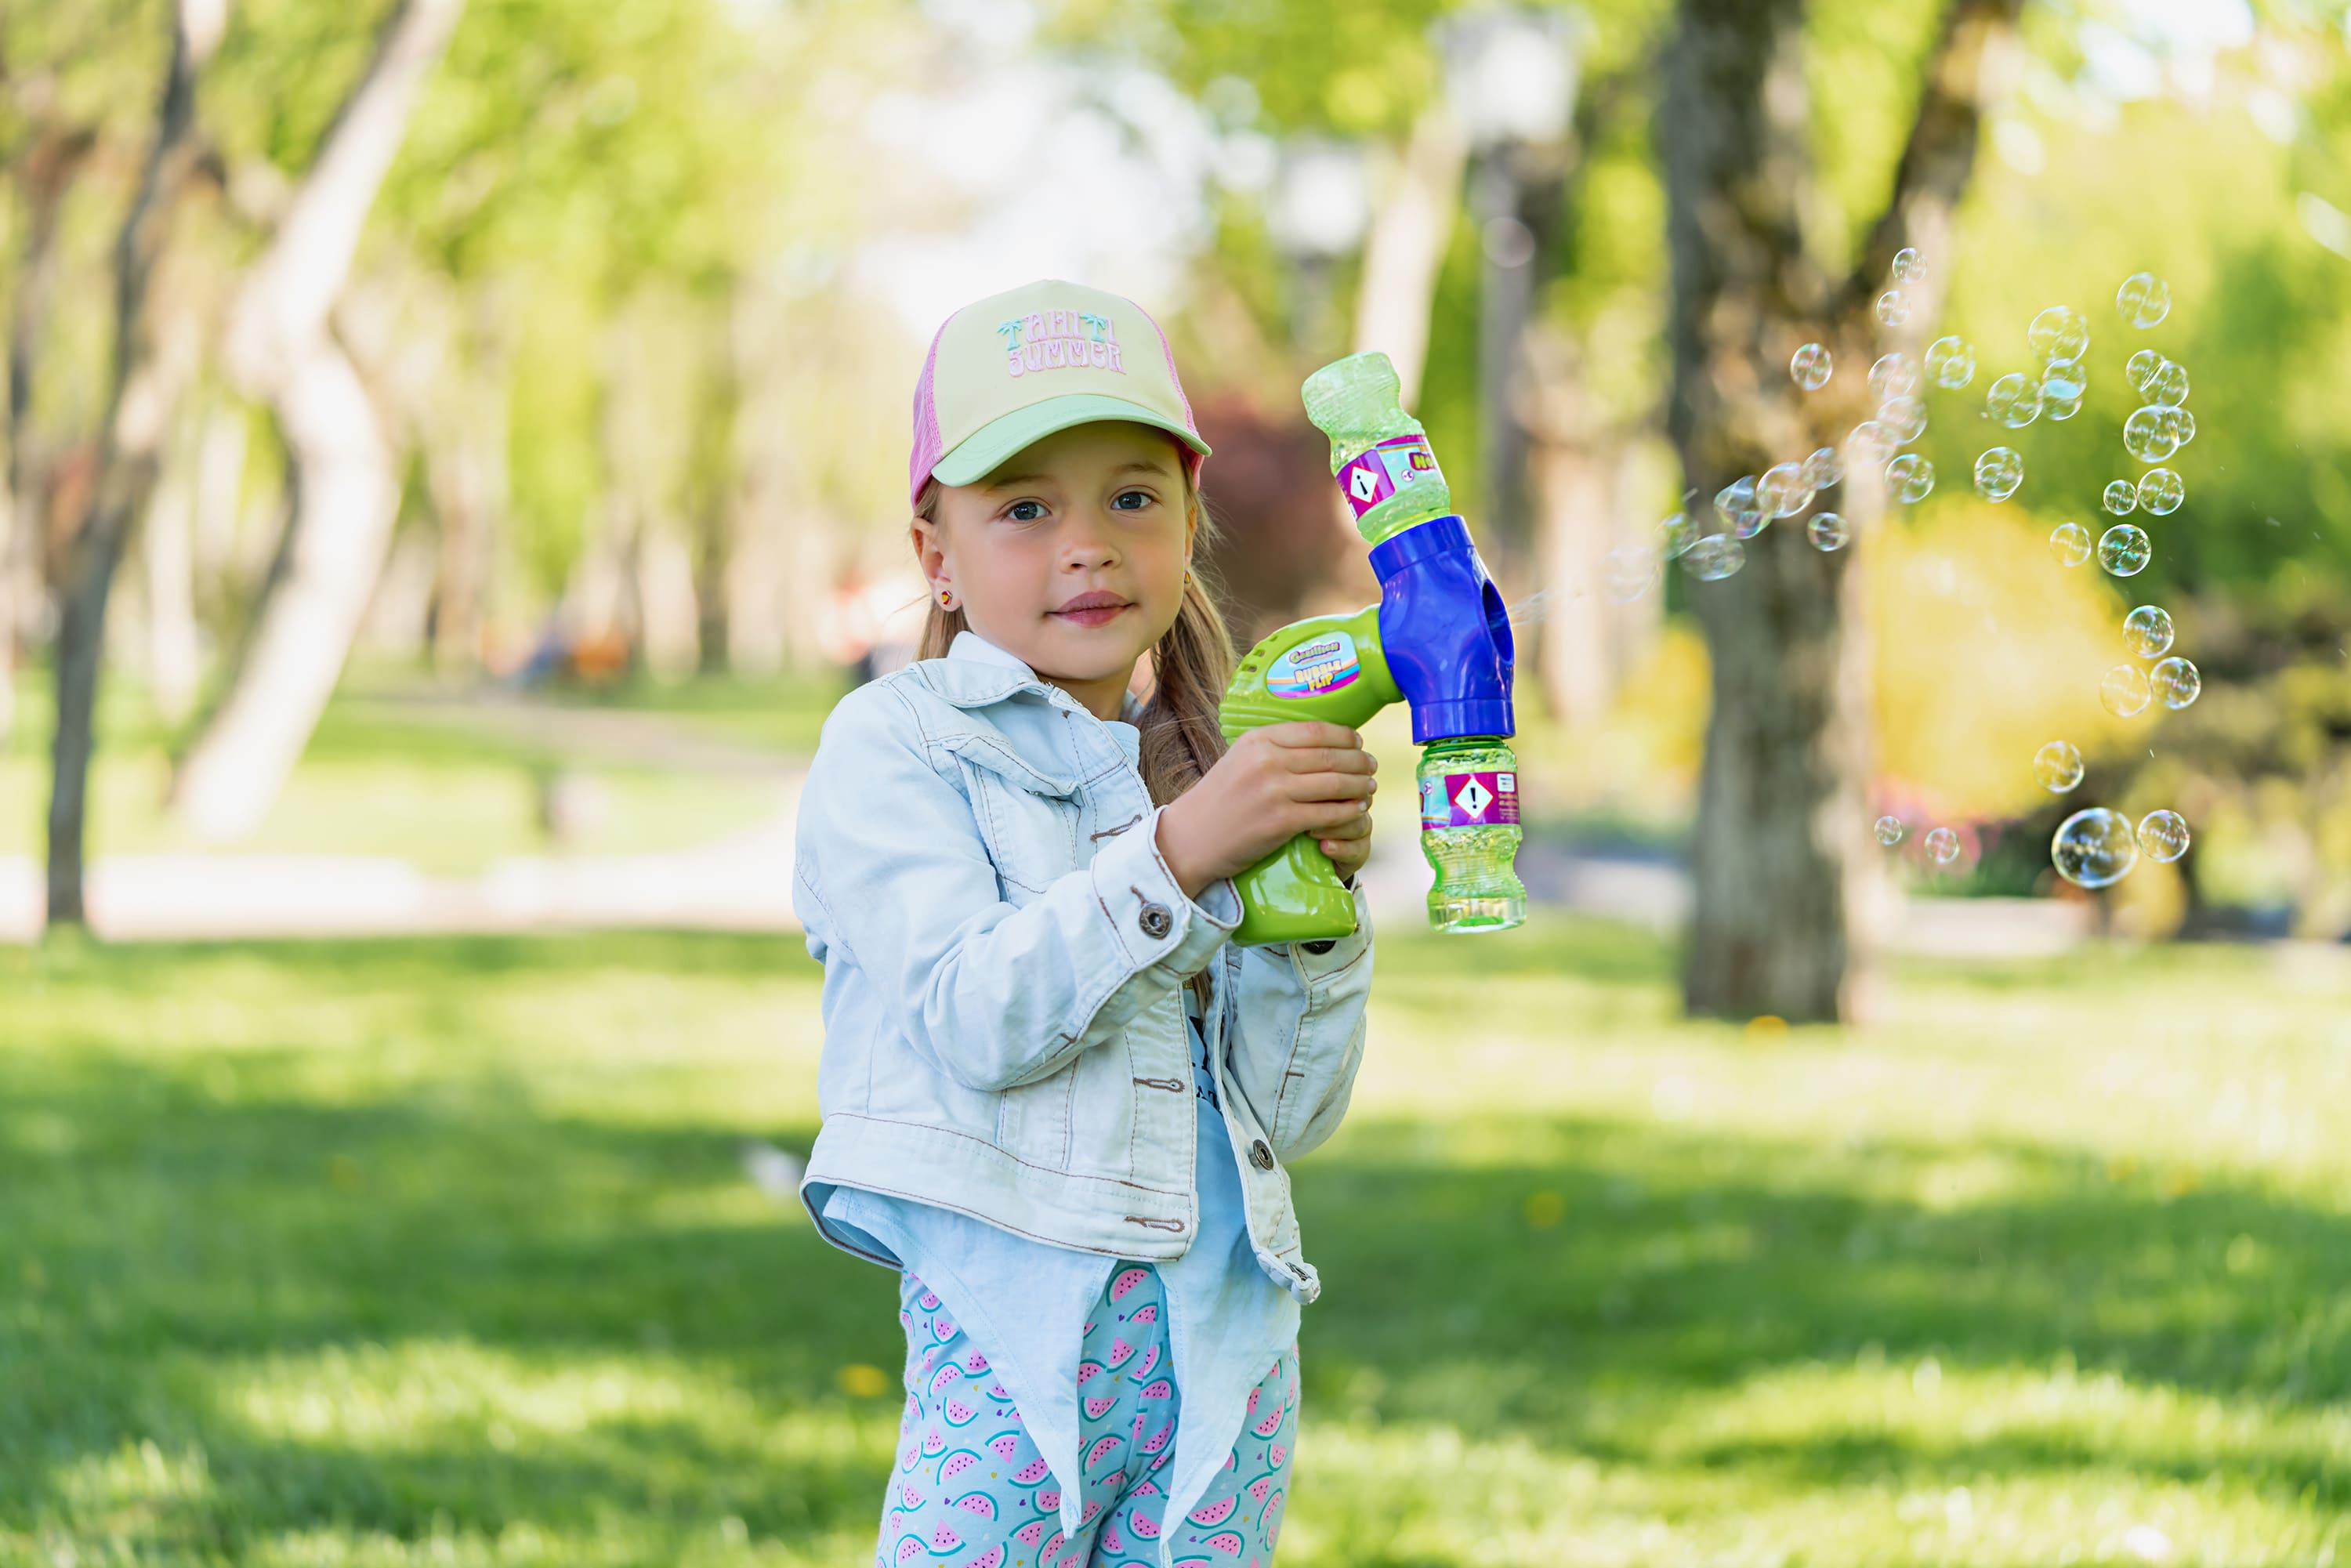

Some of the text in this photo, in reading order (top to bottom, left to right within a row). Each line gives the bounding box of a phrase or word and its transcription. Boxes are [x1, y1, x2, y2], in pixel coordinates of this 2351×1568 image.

[1009, 339, 1126, 376] SUMMER
[1295, 659, 1341, 683] BUBBLE
[1308, 672, 1333, 691] FLIP
